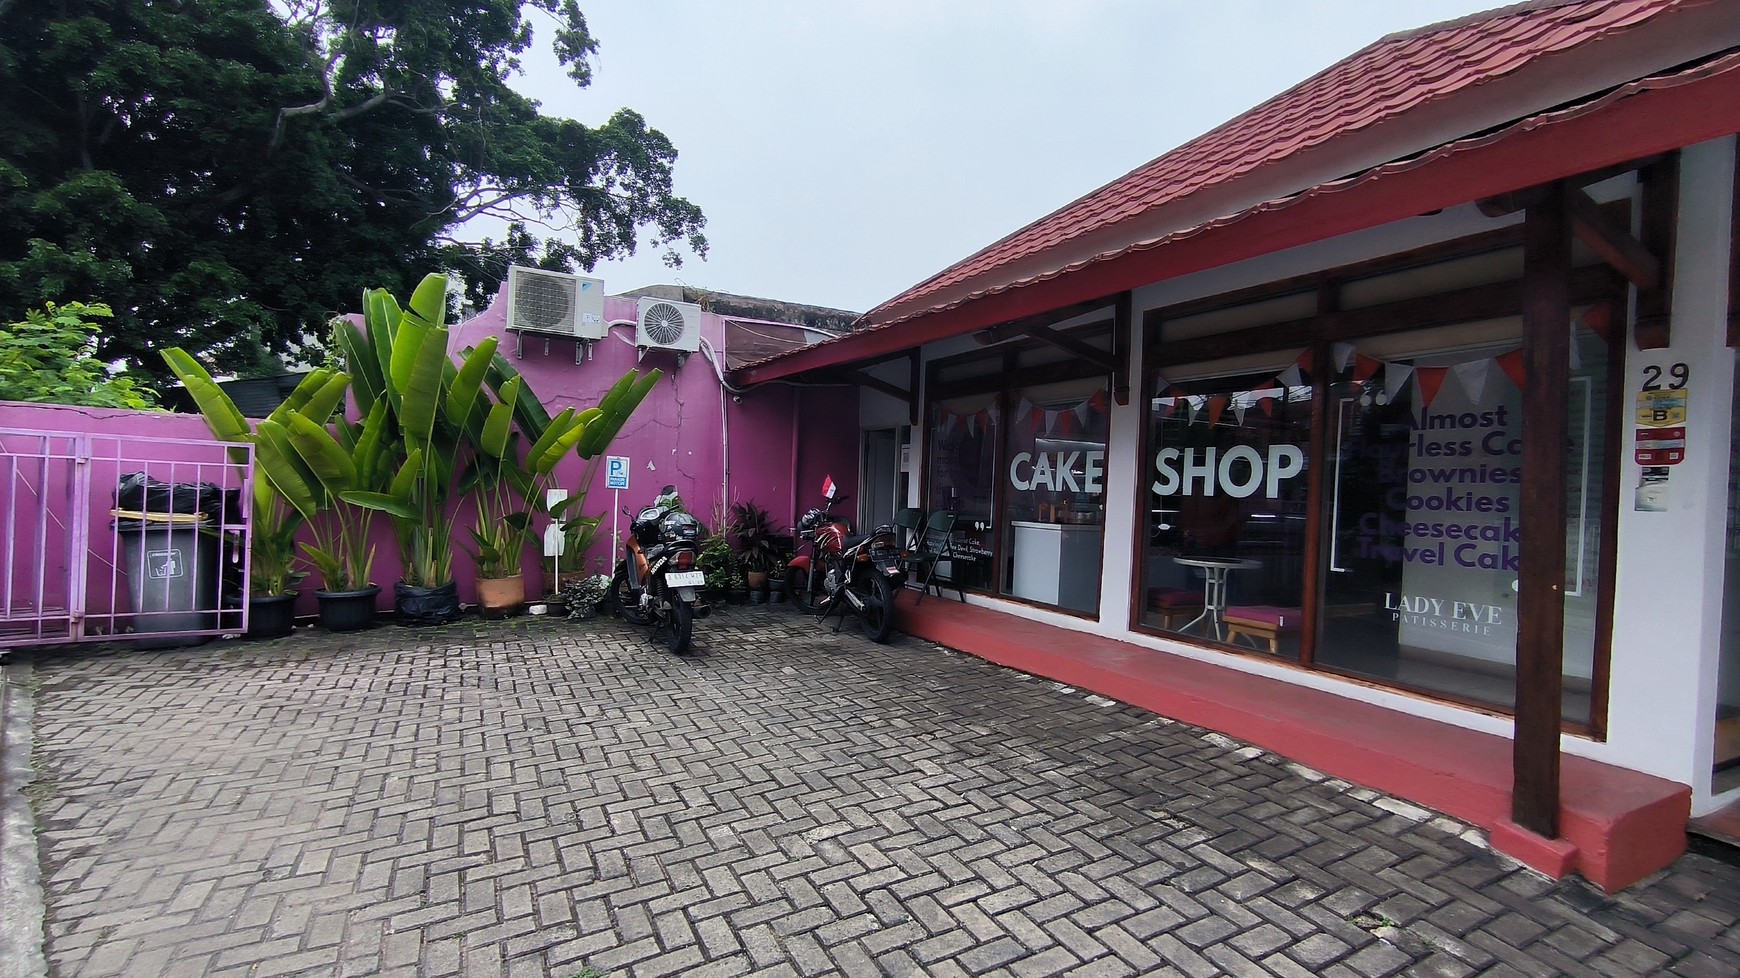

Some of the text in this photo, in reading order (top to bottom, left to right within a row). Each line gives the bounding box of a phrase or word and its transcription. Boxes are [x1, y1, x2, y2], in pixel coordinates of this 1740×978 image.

[1641, 363, 1689, 391] 29
[1398, 405, 1508, 431] Almost
[1653, 410, 1668, 421] B
[611, 461, 622, 475] P
[1010, 444, 1304, 499] CAKE SHOP
[1385, 486, 1511, 513] Cookies
[1359, 512, 1520, 543] Cheesecak
[650, 556, 667, 575] HONDA
[1453, 543, 1520, 572] Cak
[1384, 592, 1502, 625] LADY EVE
[1392, 612, 1492, 636] PATISSERIE
